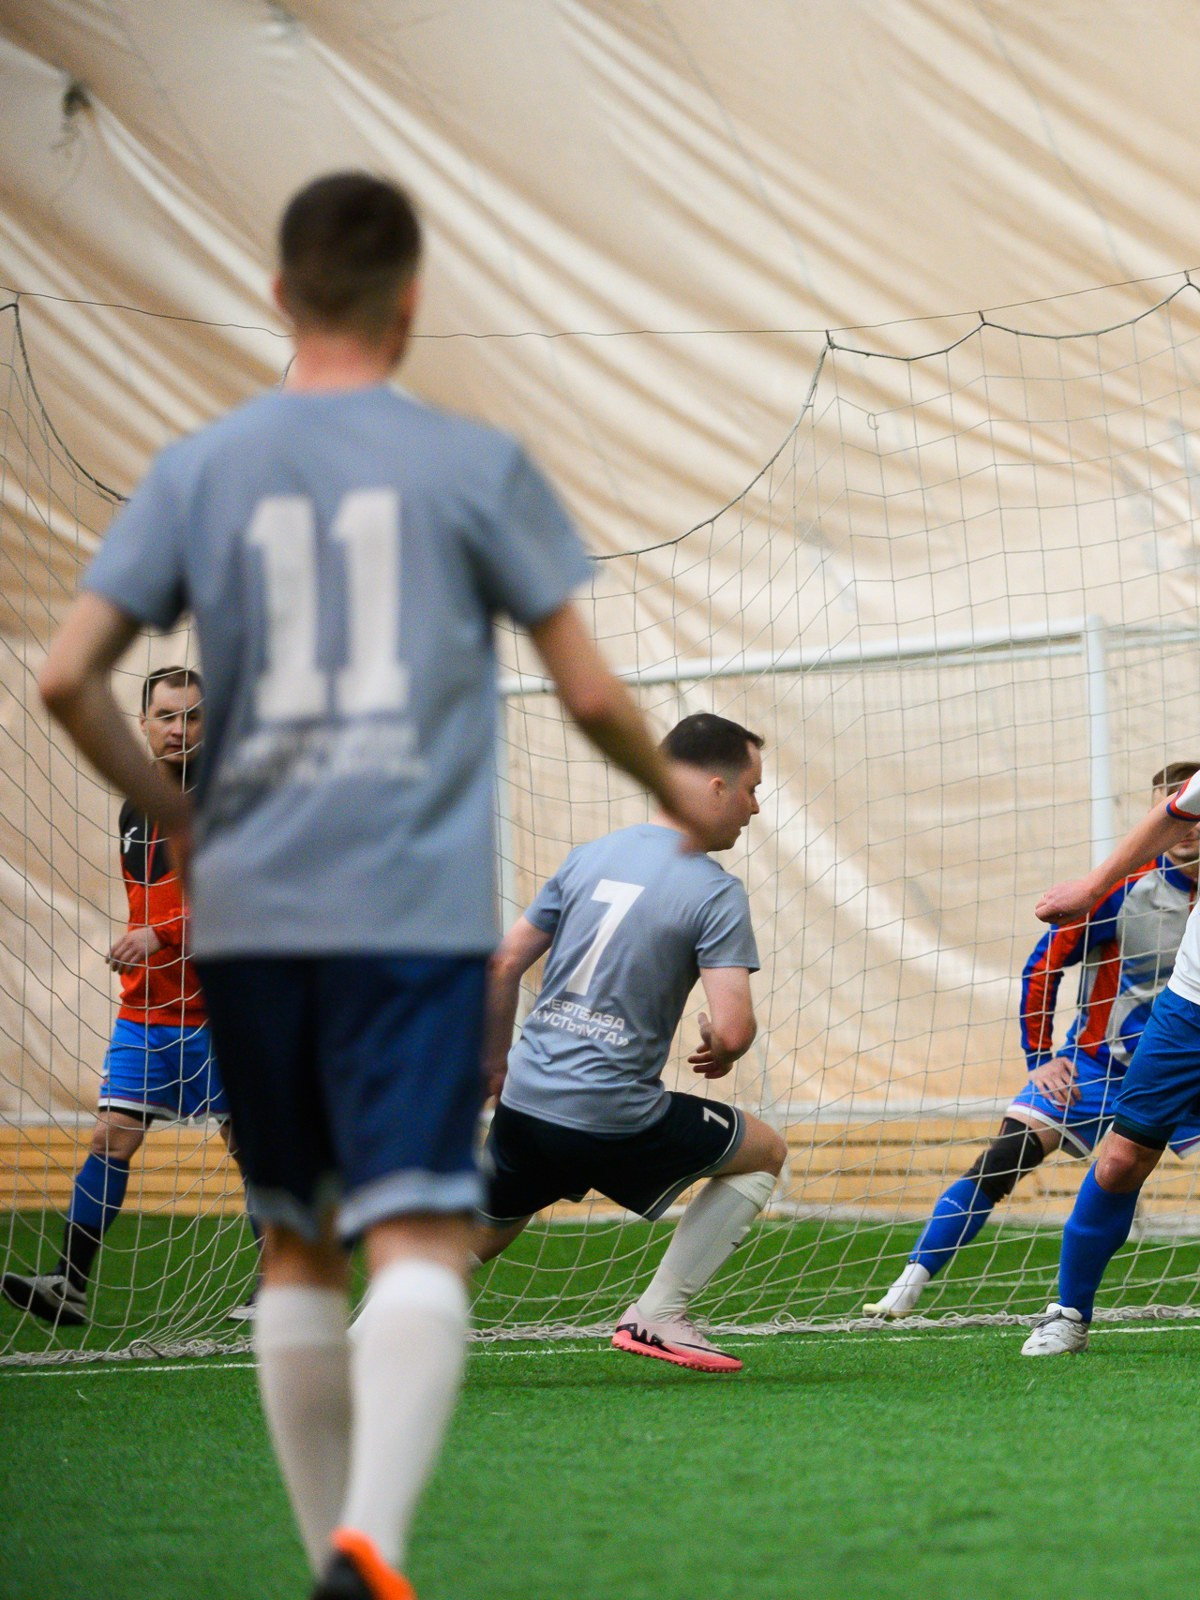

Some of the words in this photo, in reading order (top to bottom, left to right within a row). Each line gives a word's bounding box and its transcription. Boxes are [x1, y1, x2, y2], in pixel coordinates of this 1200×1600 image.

[247, 488, 409, 719] 11
[565, 878, 645, 996] 7
[703, 1106, 730, 1129] 7
